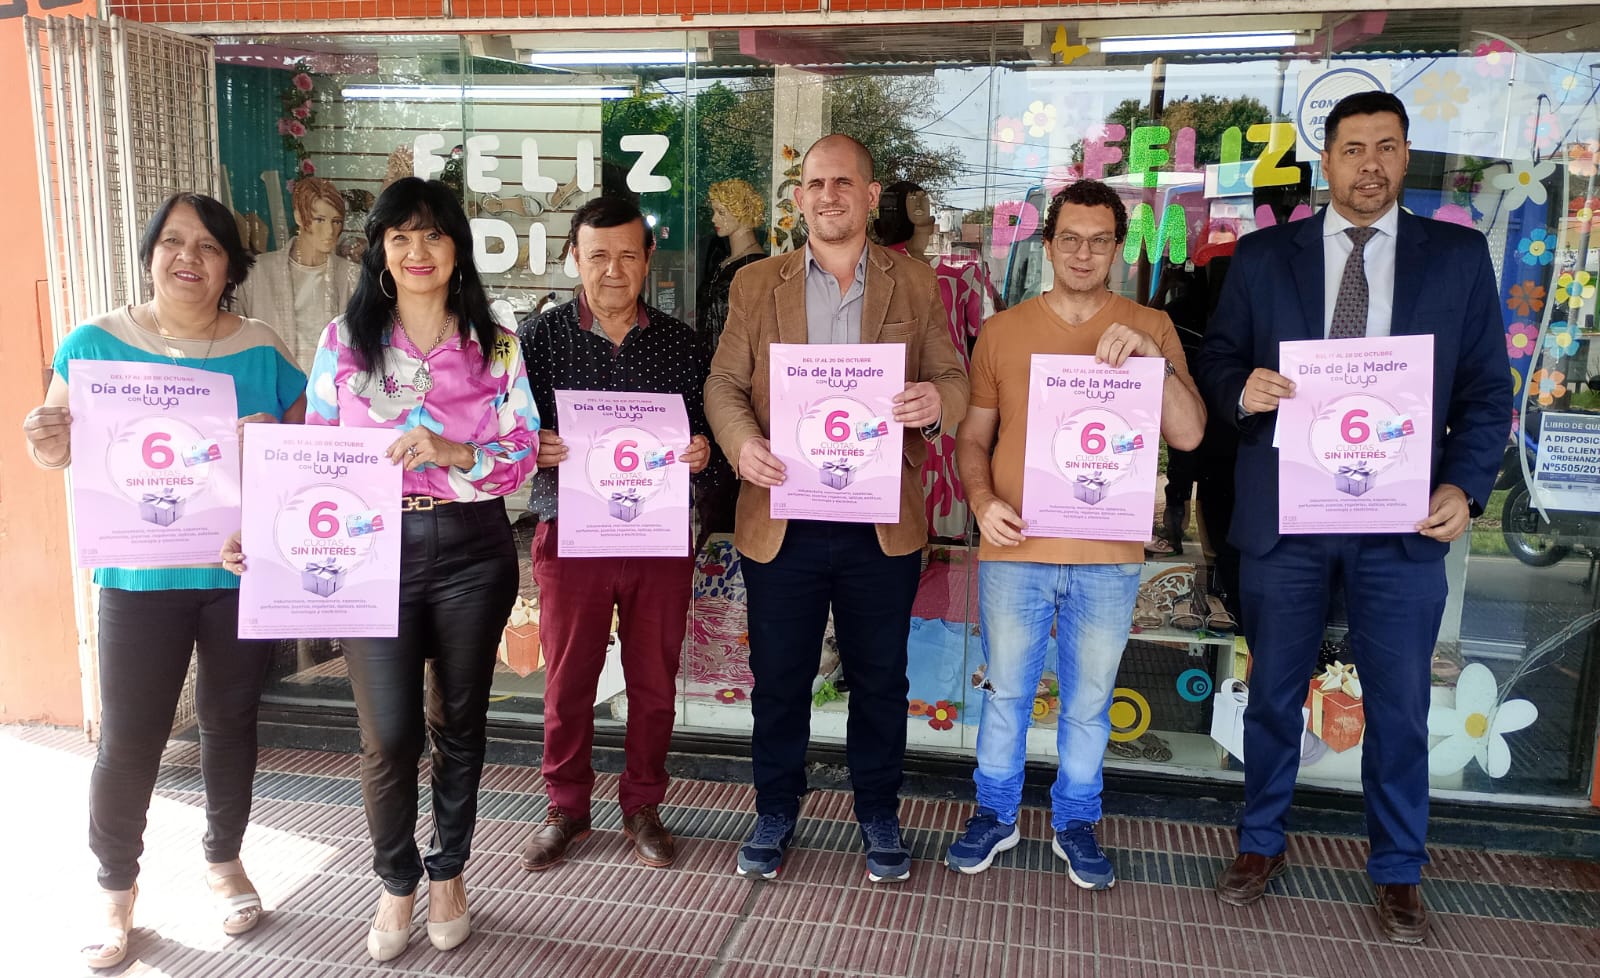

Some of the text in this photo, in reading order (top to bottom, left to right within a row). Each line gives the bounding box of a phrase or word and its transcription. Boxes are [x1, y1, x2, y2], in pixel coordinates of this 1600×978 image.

[1084, 123, 1302, 188] FELIZ
[414, 134, 672, 193] FELIZ
[470, 218, 580, 278] DI
[788, 366, 884, 377] Día de la Madre
[1298, 360, 1408, 375] Día de la Madre
[828, 377, 858, 392] tuya
[1046, 376, 1142, 390] Día de la Madre
[1344, 372, 1378, 388] tuya
[91, 383, 211, 396] Día de la Madre
[1086, 388, 1115, 404] tuya
[143, 394, 180, 410] tuya
[574, 404, 594, 412] Día
[630, 404, 666, 412] Madre
[615, 411, 643, 422] tuya
[824, 410, 850, 442] 6
[1340, 408, 1370, 444] 6
[1544, 421, 1570, 429] LIBRO
[1080, 422, 1106, 454] 6
[142, 432, 175, 470] 6
[264, 450, 378, 464] Día de la Madre
[614, 440, 639, 472] 6
[828, 448, 864, 456] INTERÉS
[1324, 450, 1386, 460] SIN INTERÉS
[313, 462, 348, 480] tuya
[1082, 460, 1119, 470] INTERÉS
[126, 475, 194, 486] SIN INTERÉS
[616, 478, 653, 486] INTERÉS
[308, 500, 340, 538] 6
[304, 538, 344, 546] CUOTAS
[290, 546, 356, 556] SIN INTERÉS
